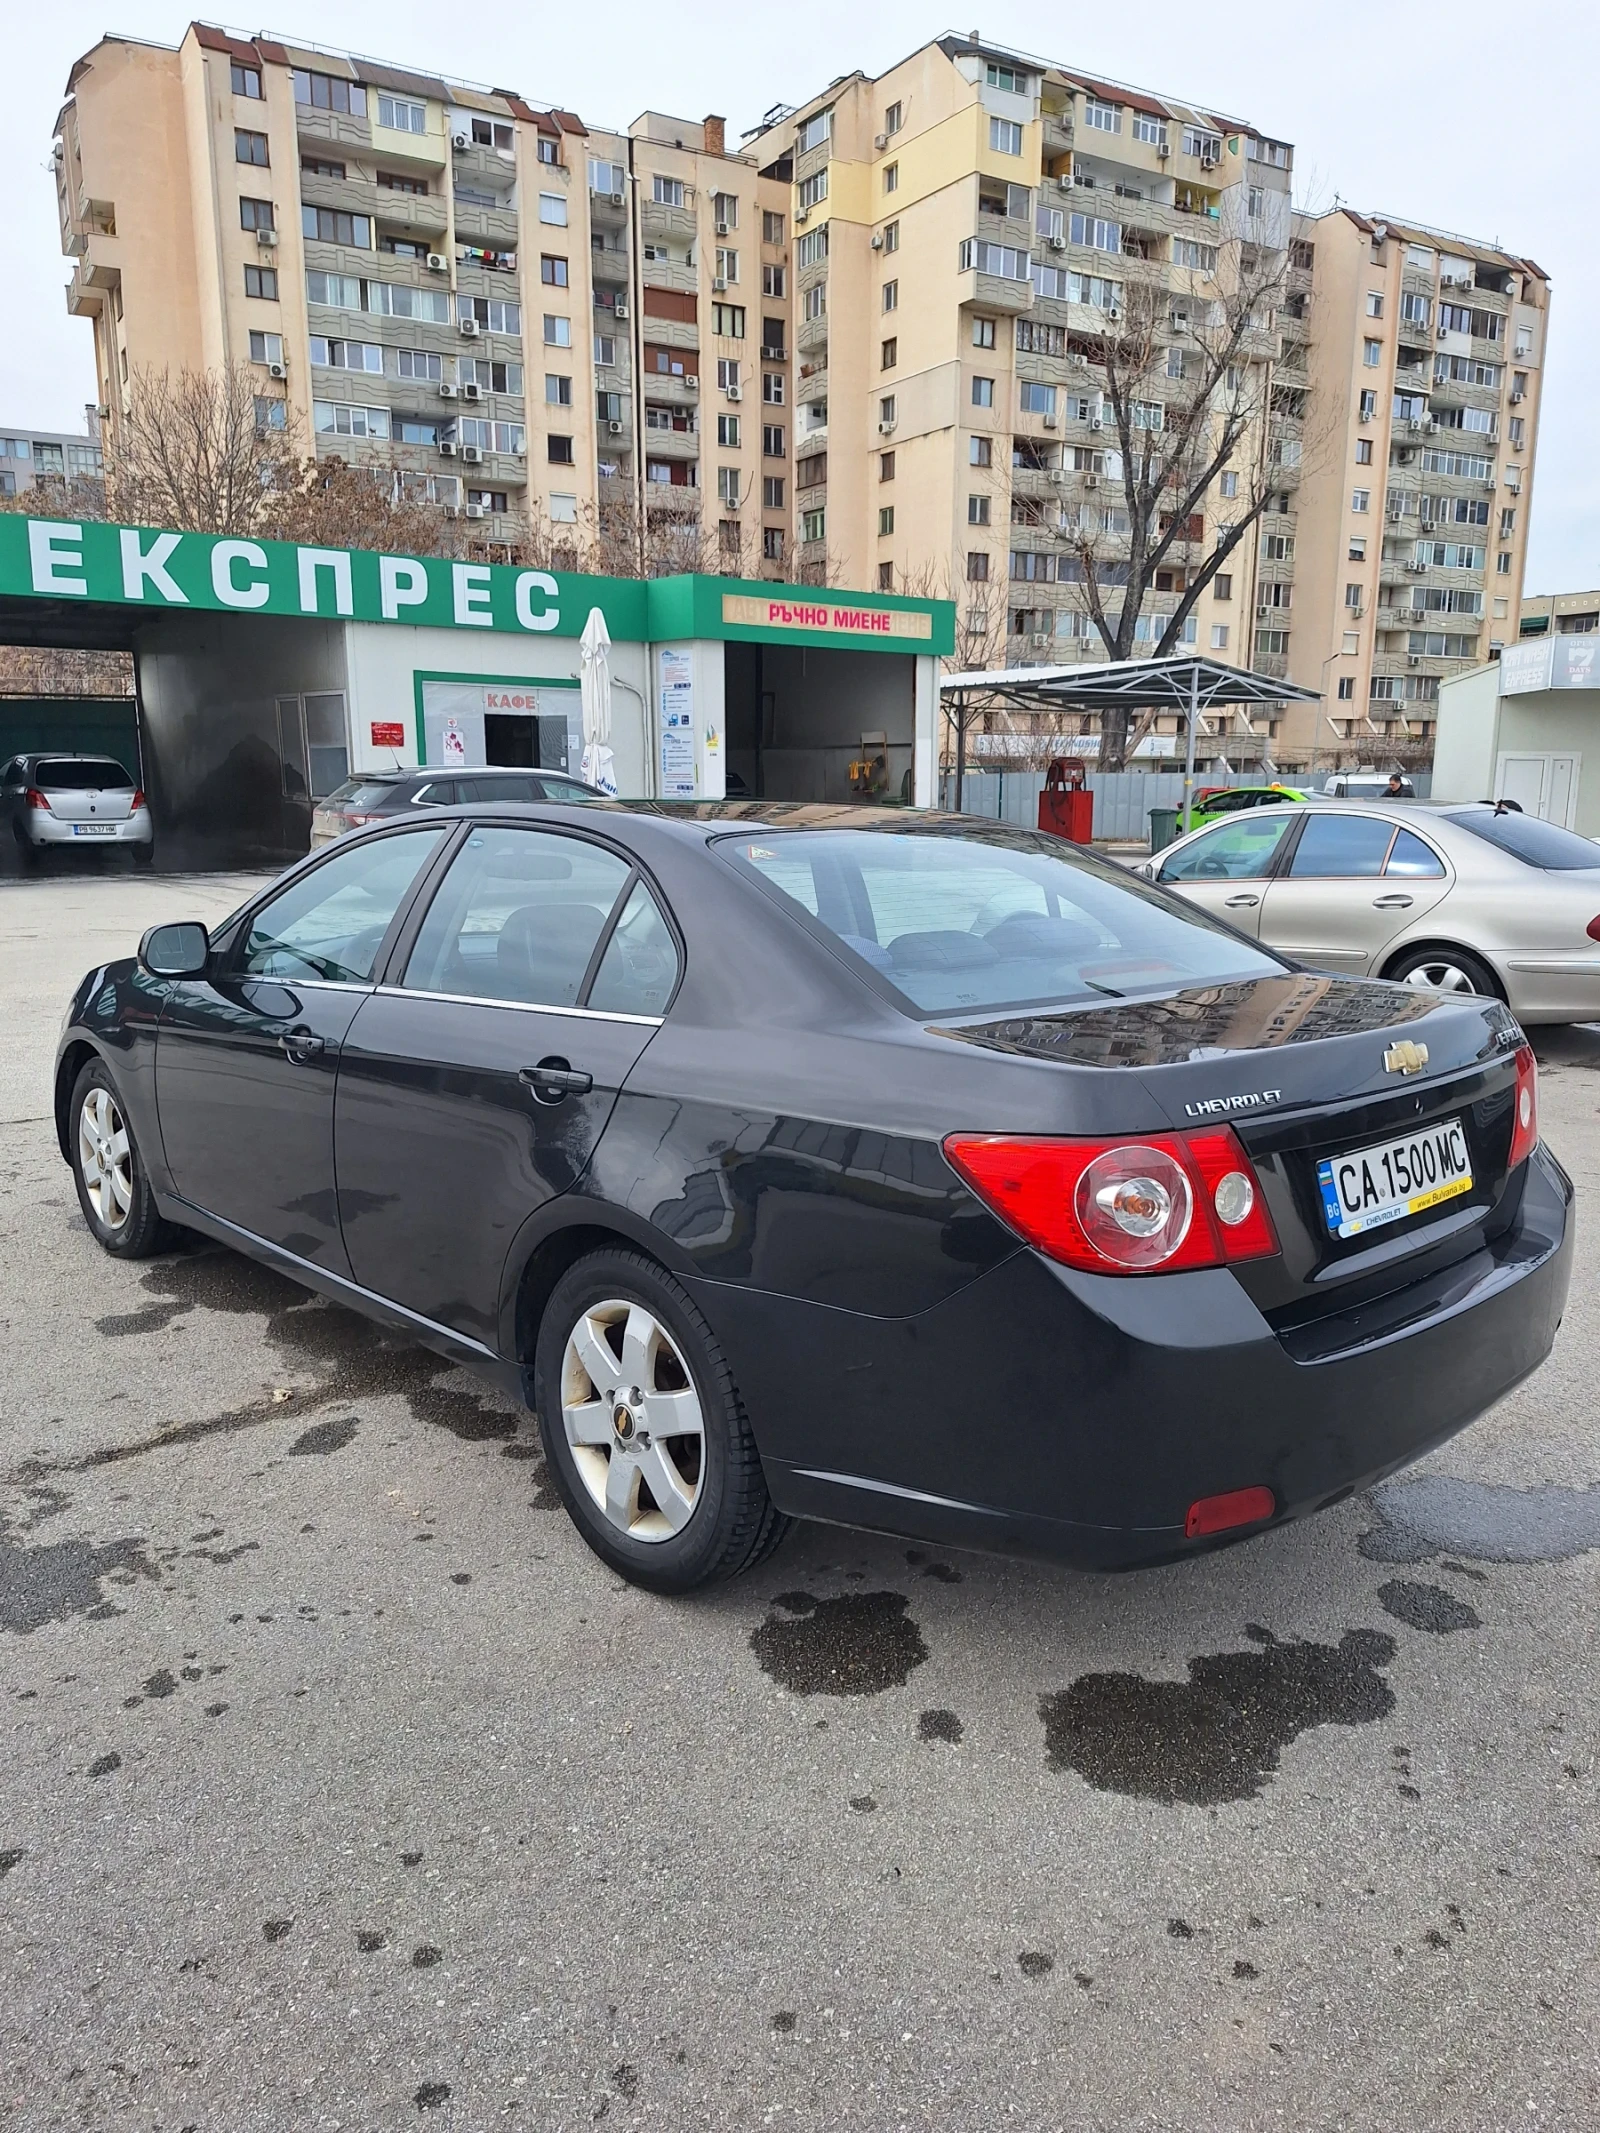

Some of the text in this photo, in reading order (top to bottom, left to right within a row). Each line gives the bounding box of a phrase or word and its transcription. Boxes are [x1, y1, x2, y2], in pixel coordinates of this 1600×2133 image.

[27, 519, 560, 632] ЕКСПРЕС
[769, 603, 828, 626] РЪЧНО
[833, 609, 891, 632] МИЕНЕ
[1524, 643, 1549, 664] WASH
[1568, 647, 1595, 682] 7
[1505, 667, 1544, 688] EXPRESS
[487, 693, 536, 710] КАФЕ
[1339, 1129, 1466, 1213] CA 1500 MC
[1327, 1202, 1340, 1219] BG
[1366, 1207, 1402, 1226] CHEVROLET
